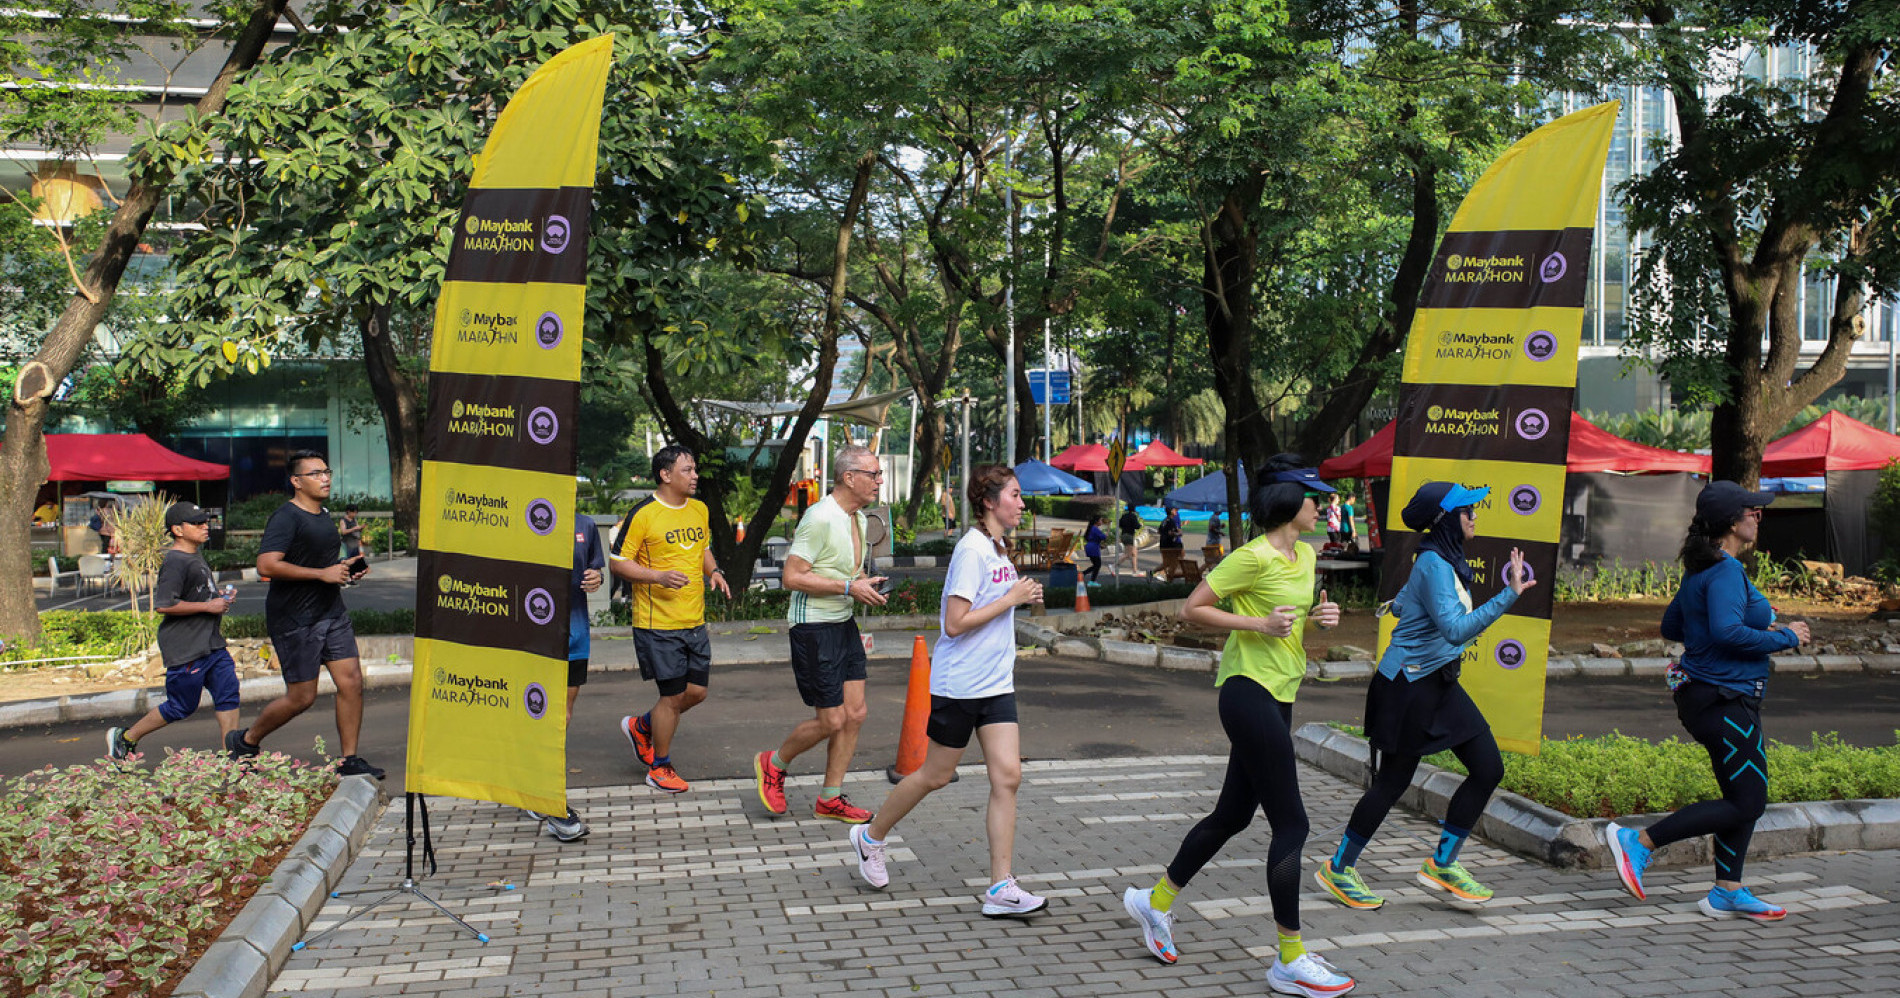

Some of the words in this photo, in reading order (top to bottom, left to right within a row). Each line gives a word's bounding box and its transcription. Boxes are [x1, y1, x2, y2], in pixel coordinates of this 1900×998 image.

[480, 219, 533, 234] Maybank
[1462, 254, 1524, 268] Maybank
[1444, 267, 1524, 285] MARATHON
[1453, 332, 1514, 345] Maybank
[1444, 408, 1499, 421] Maybank
[456, 492, 508, 509] Maybank
[452, 579, 508, 599] Maybank
[447, 673, 508, 691] Maybank
